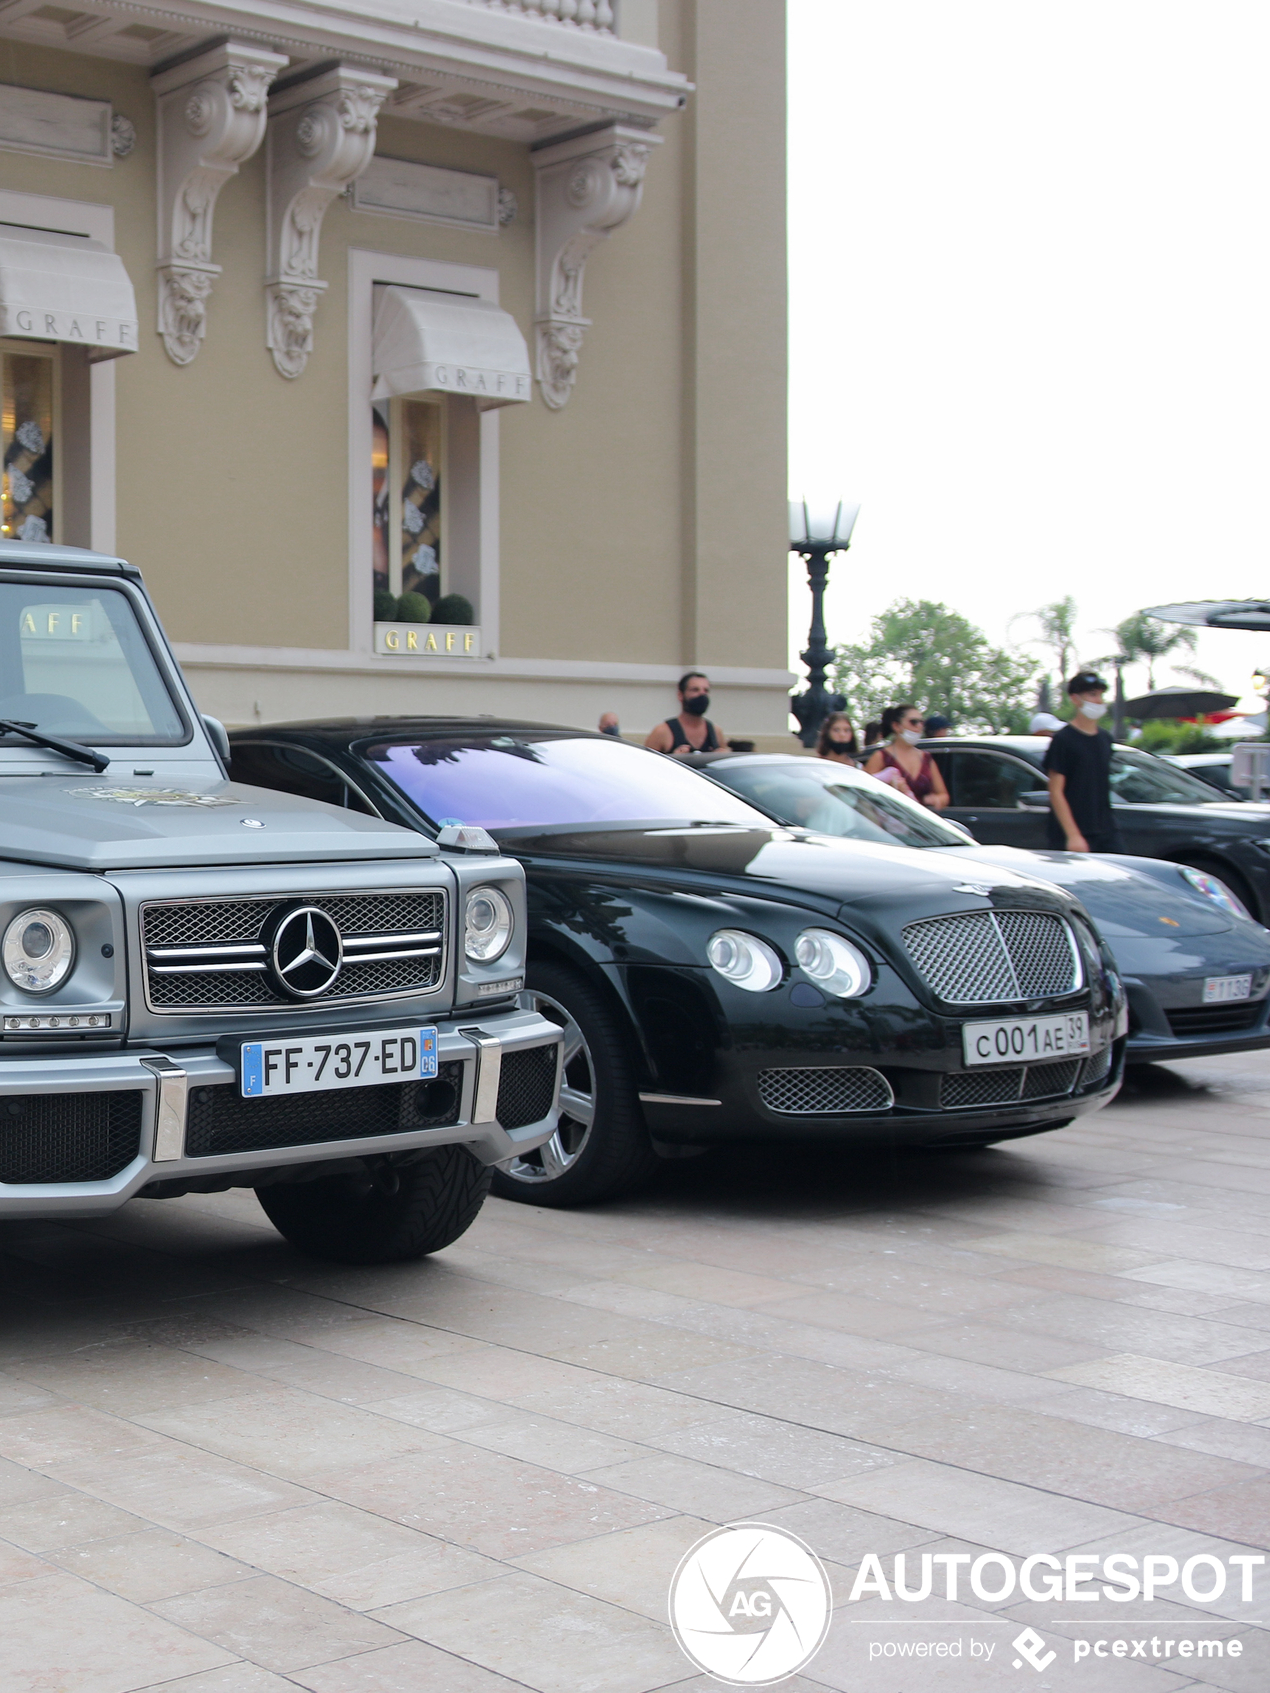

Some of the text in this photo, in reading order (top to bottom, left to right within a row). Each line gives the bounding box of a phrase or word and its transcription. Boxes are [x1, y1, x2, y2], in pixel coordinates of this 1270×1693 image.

[16, 310, 130, 344] GRAFF
[435, 365, 527, 395] GRAFF
[21, 612, 83, 634] AFF
[385, 629, 475, 653] GRAFF
[1069, 1016, 1083, 1040] 39
[249, 1075, 257, 1087] F
[264, 1036, 417, 1087] FF-737-ED
